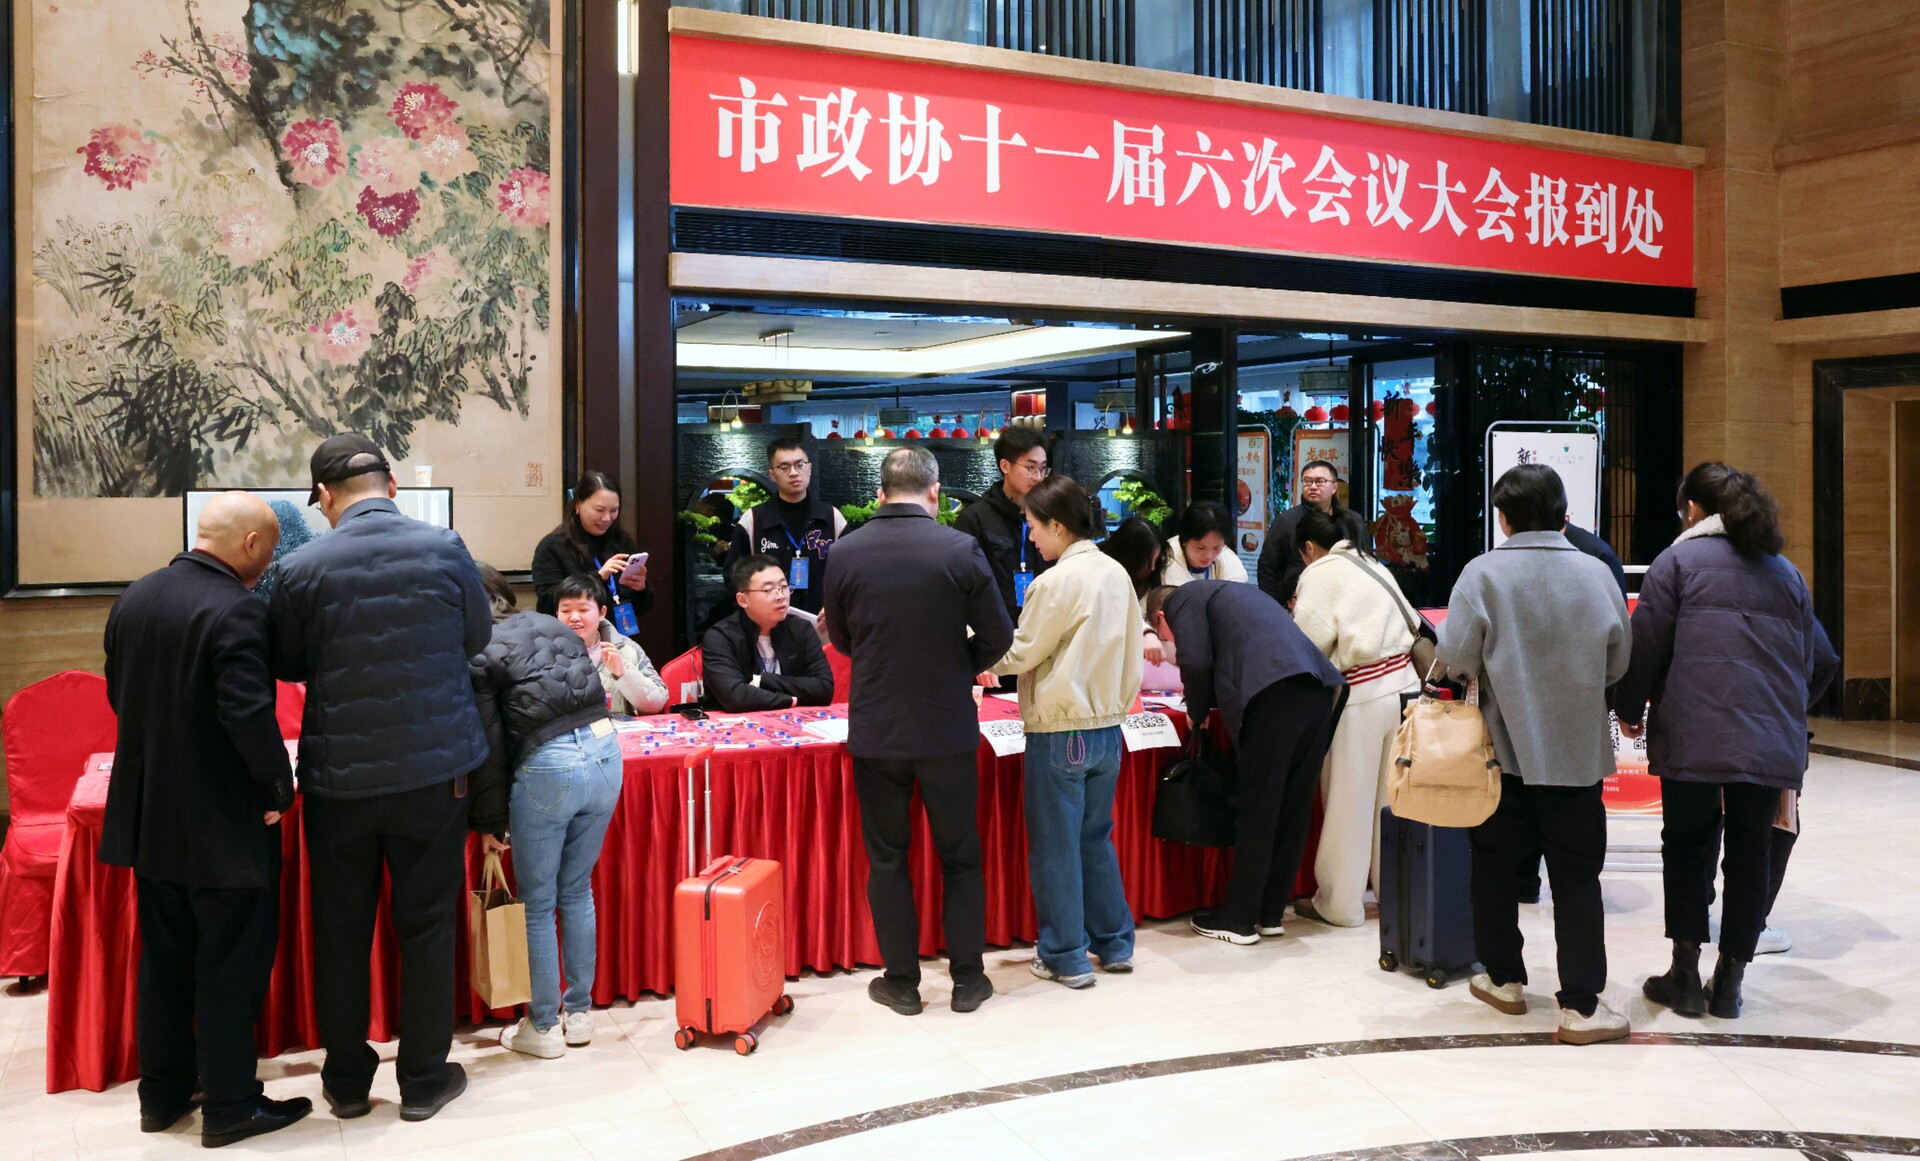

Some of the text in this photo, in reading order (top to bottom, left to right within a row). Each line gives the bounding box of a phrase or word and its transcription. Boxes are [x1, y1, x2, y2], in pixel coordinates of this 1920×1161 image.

[709, 76, 1664, 259] 市政协十一届六次会议大会报到处
[761, 538, 779, 553] Jim
